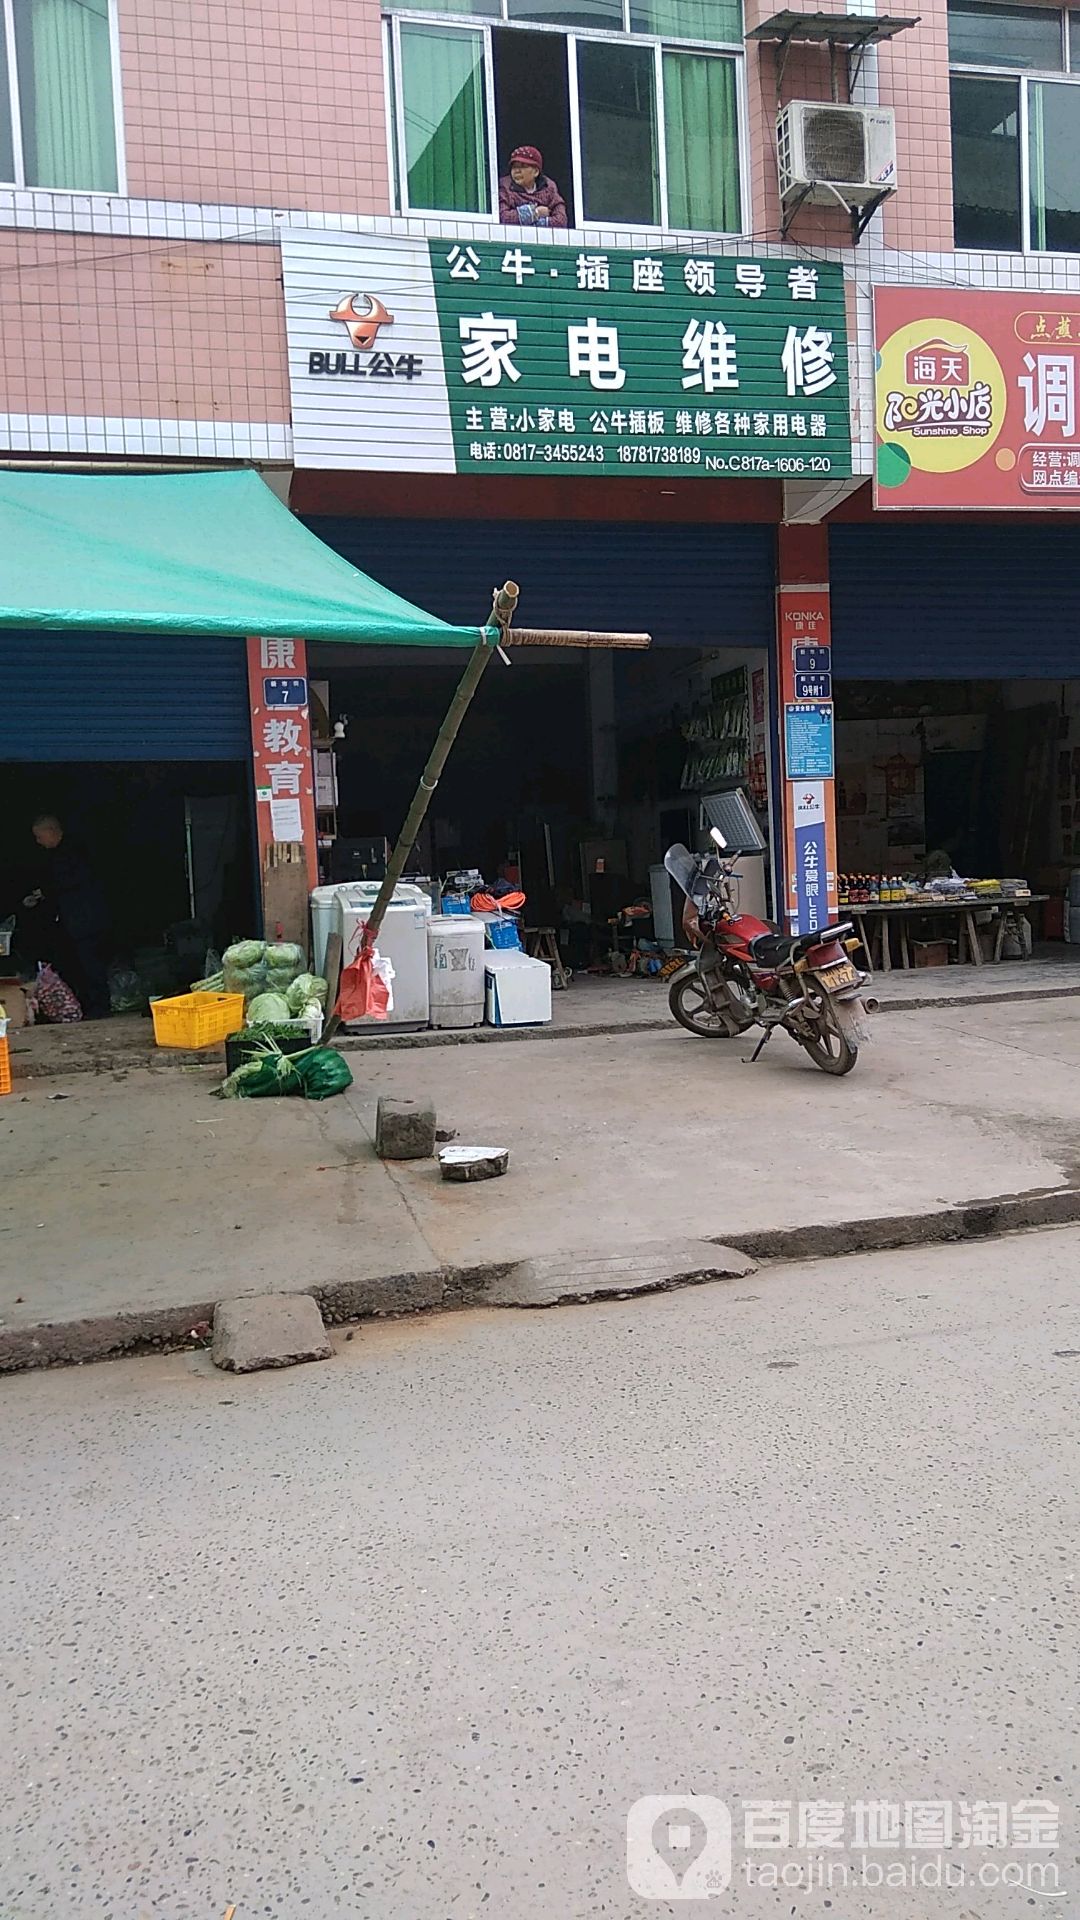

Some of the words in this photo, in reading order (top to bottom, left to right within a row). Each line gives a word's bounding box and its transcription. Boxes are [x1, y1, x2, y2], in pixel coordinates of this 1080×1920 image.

[459, 312, 838, 397] 家电维修
[914, 355, 963, 382] 海天
[885, 383, 992, 428] 阳光小店
[1018, 352, 1075, 437] 调
[466, 406, 576, 433] 主营:小家电
[589, 408, 665, 435] 公牛插板
[676, 410, 827, 437] 维修各种家用电器
[914, 427, 959, 436] Sunshine
[963, 426, 988, 437] Shop
[470, 442, 604, 462] 电话:0817-3455243
[617, 445, 701, 464] 18781738189
[705, 455, 831, 473] No.C817a-1606-120
[1032, 470, 1080, 486] 网点编
[785, 612, 825, 621] KONKA
[809, 658, 816, 670] 9
[281, 691, 289, 703] 7
[803, 841, 820, 933] 公牛爱眼LED
